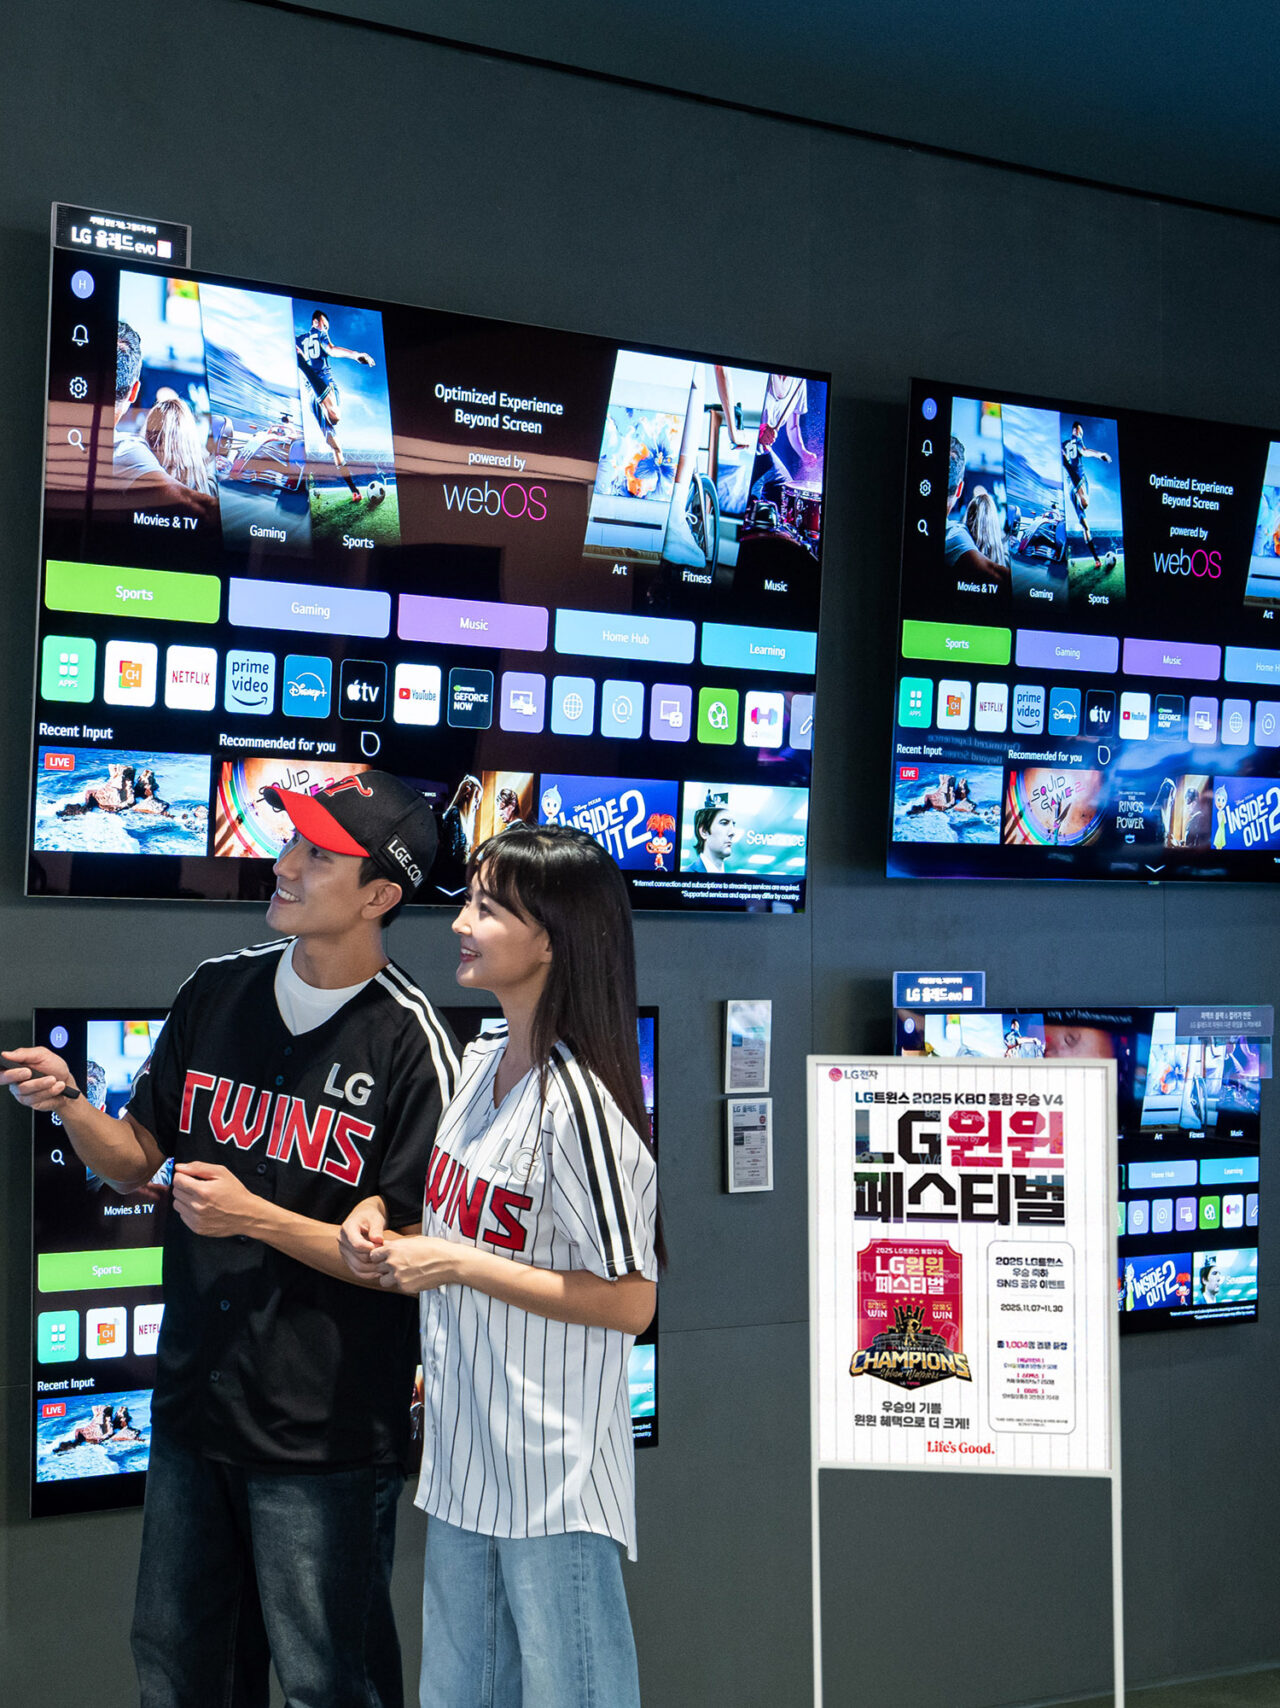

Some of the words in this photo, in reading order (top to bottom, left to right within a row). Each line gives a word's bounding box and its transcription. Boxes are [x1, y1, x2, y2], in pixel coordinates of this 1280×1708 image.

[71, 226, 92, 244] LG
[135, 242, 156, 255] evo
[434, 383, 496, 408] Optimized
[499, 392, 564, 416] Experience
[454, 408, 500, 431] Beyond
[502, 414, 543, 435] Screen
[468, 452, 511, 468] powered
[513, 453, 527, 472] by
[1149, 474, 1190, 491] Optimized
[1191, 480, 1234, 496] Experience
[443, 481, 547, 521] webOS
[1162, 493, 1191, 510] Beyond
[1192, 497, 1219, 511] Screen
[133, 513, 170, 528] Movies
[173, 516, 181, 528] &
[183, 517, 198, 529] TV
[249, 524, 287, 542] Gaming
[1170, 525, 1200, 538] powered
[1201, 528, 1208, 541] by
[343, 535, 375, 549] Sports
[612, 564, 628, 576] Art
[1153, 548, 1222, 579] webOS
[682, 571, 713, 584] Fitness
[115, 585, 154, 602] Sports
[764, 579, 788, 593] Music
[1029, 587, 1054, 602] Gaming
[1088, 593, 1109, 605] Sports
[291, 602, 331, 620] Gaming
[460, 617, 489, 632] Music
[602, 630, 629, 644] Home
[631, 632, 650, 645] Hub
[945, 637, 969, 651] Sports
[749, 643, 786, 659] Learning
[1055, 645, 1081, 660] Gaming
[231, 659, 270, 677] prime
[1162, 655, 1182, 667] Music
[171, 670, 211, 686] NETFLIX
[231, 676, 269, 694] video
[361, 682, 380, 703] tv
[412, 689, 436, 702] YouTube
[454, 691, 489, 704] GEFORCE
[453, 701, 473, 712] NOW
[1017, 705, 1041, 719] video
[39, 722, 80, 738] Recent
[82, 725, 114, 741] Input
[219, 734, 296, 750] Recommended
[298, 737, 316, 751] for
[317, 739, 336, 755] you
[896, 743, 922, 755] Recent
[923, 744, 942, 757] Input
[49, 756, 71, 768] LIVE
[1008, 749, 1057, 763] Recommended
[1058, 752, 1068, 762] for
[1069, 754, 1083, 765] you
[620, 789, 652, 850] 2
[1226, 793, 1269, 834] INSIDE
[1243, 814, 1269, 847] OUT
[745, 830, 806, 848] Severance
[844, 1069, 878, 1081] LG전자
[323, 1062, 376, 1107] LG
[855, 1091, 910, 1105] LG트윈스
[912, 1092, 951, 1105] 2025
[954, 1093, 986, 1105] KBO
[988, 1093, 1013, 1107] 통합
[1015, 1093, 1040, 1107] 우승
[1042, 1094, 1064, 1106] V4
[178, 1068, 376, 1188] TWINS
[855, 1109, 1065, 1169] LG윈윈
[489, 1137, 542, 1184] LG
[423, 1144, 534, 1252] WINS
[854, 1171, 1066, 1227] 페스티벌
[104, 1206, 132, 1216] Movies
[134, 1204, 141, 1215] &
[142, 1203, 154, 1214] TV
[875, 1255, 944, 1276] LG윈윈
[995, 1256, 1023, 1266] 2025
[1025, 1257, 1064, 1267] LG트윈스
[92, 1265, 122, 1277] Sports
[875, 1276, 945, 1295] 페스티벌
[996, 1278, 1019, 1288] SNS
[1039, 1279, 1066, 1290] 이벤트
[1146, 1280, 1167, 1307] OUT
[867, 1309, 888, 1318] WIN
[932, 1311, 953, 1319] WIN
[850, 1350, 971, 1378] CHAMPIONS
[37, 1378, 69, 1392] Recent
[71, 1377, 95, 1391] Input
[881, 1400, 916, 1414] 우승의
[854, 1414, 877, 1427] 윈윈
[880, 1415, 926, 1429] 혜택으로
[928, 1416, 940, 1429] 더
[942, 1417, 971, 1430] 크게!
[927, 1440, 957, 1455] Life's
[958, 1442, 996, 1456] Good.
